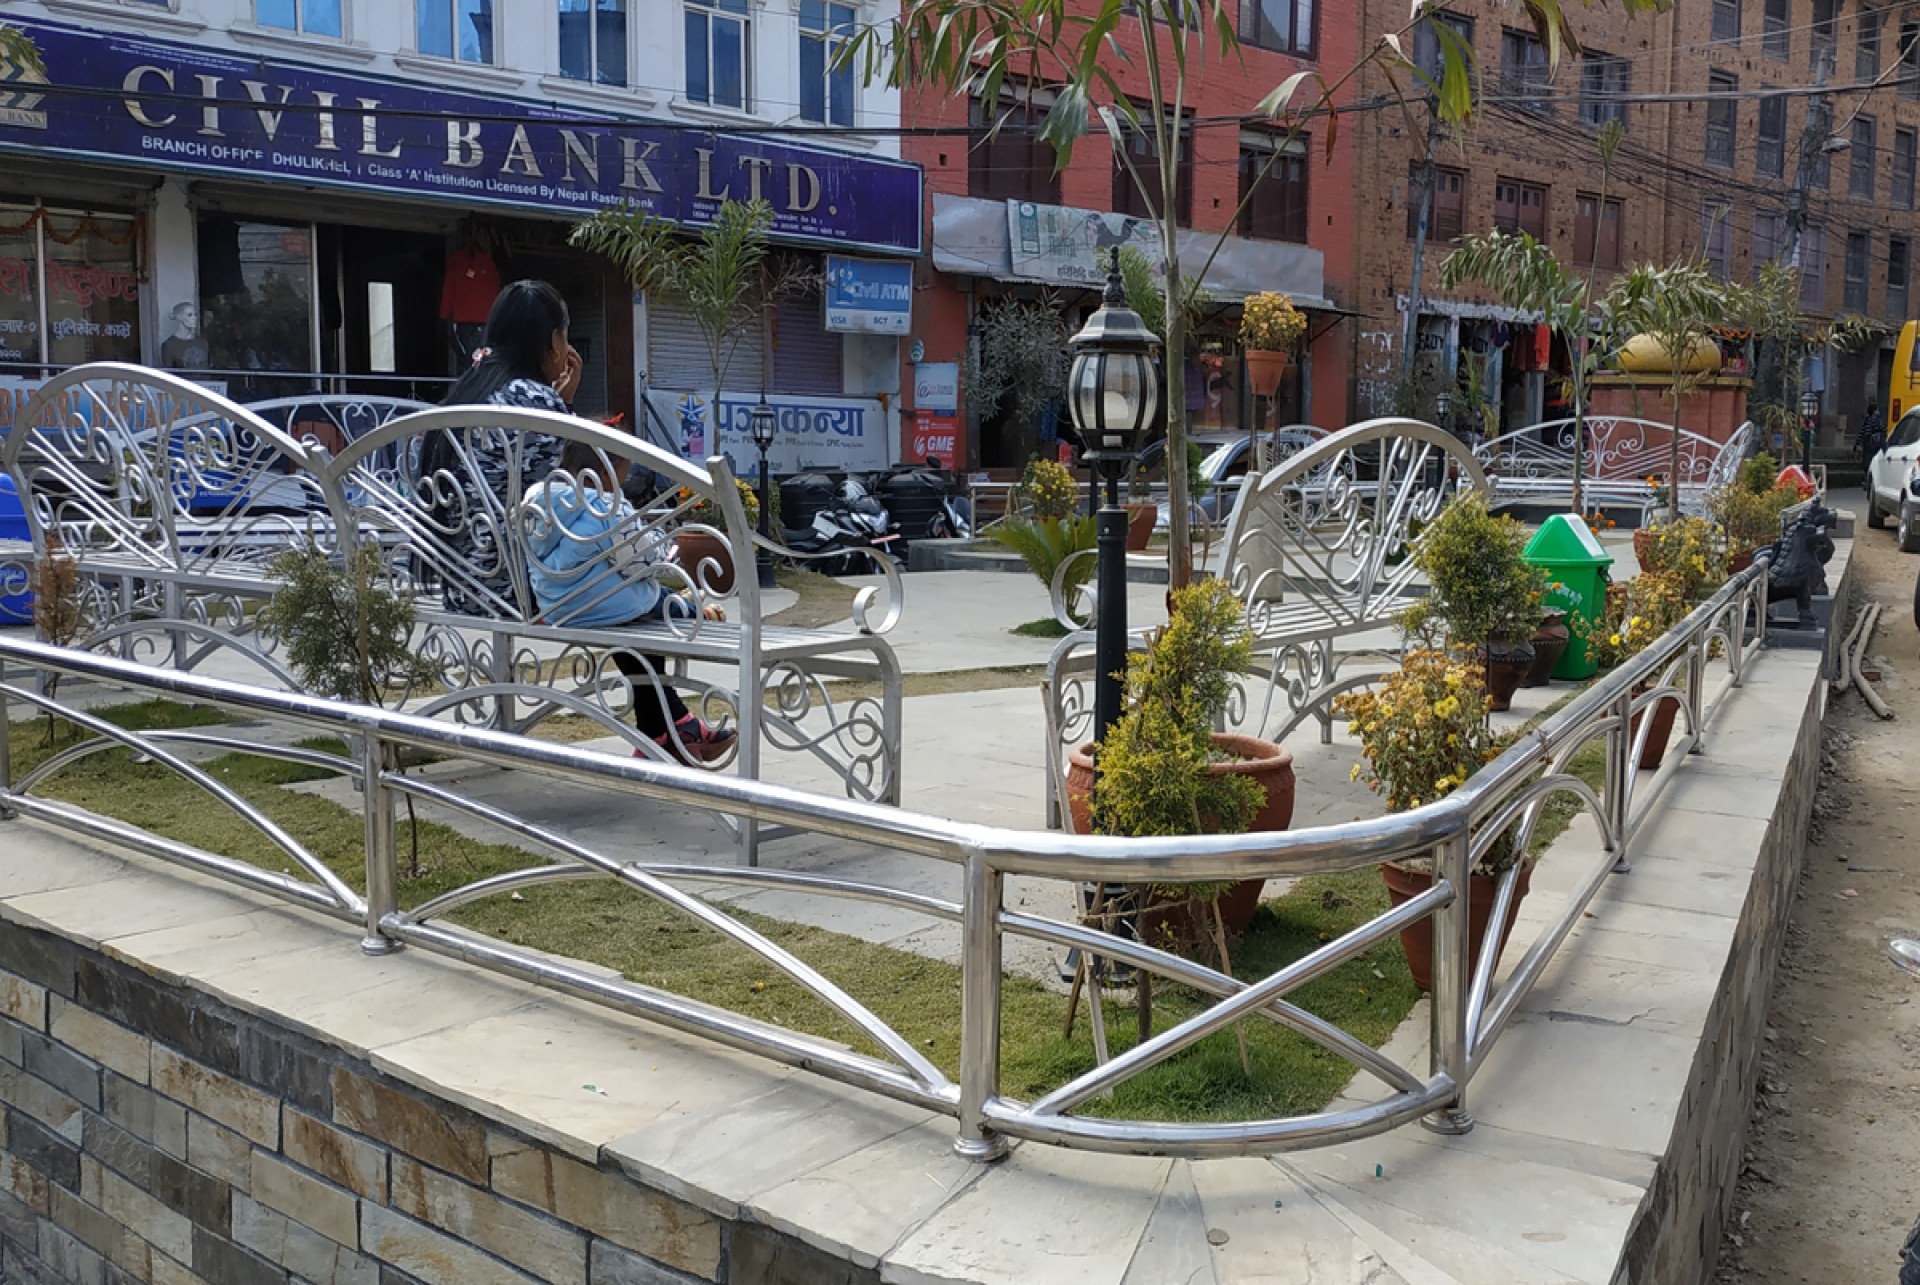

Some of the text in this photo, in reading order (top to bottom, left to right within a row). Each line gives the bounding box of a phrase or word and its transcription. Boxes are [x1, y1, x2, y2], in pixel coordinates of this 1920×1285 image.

[122, 65, 838, 216] CIVIL BANK LTD.
[141, 135, 207, 158] BRANCH
[367, 163, 402, 179] Class
[423, 168, 483, 190] Institution
[486, 178, 537, 196] Licensed
[540, 183, 555, 199] By
[558, 187, 588, 202] Nepal
[881, 283, 910, 301] ATM
[830, 315, 848, 325] VISA
[927, 435, 955, 451] GME
